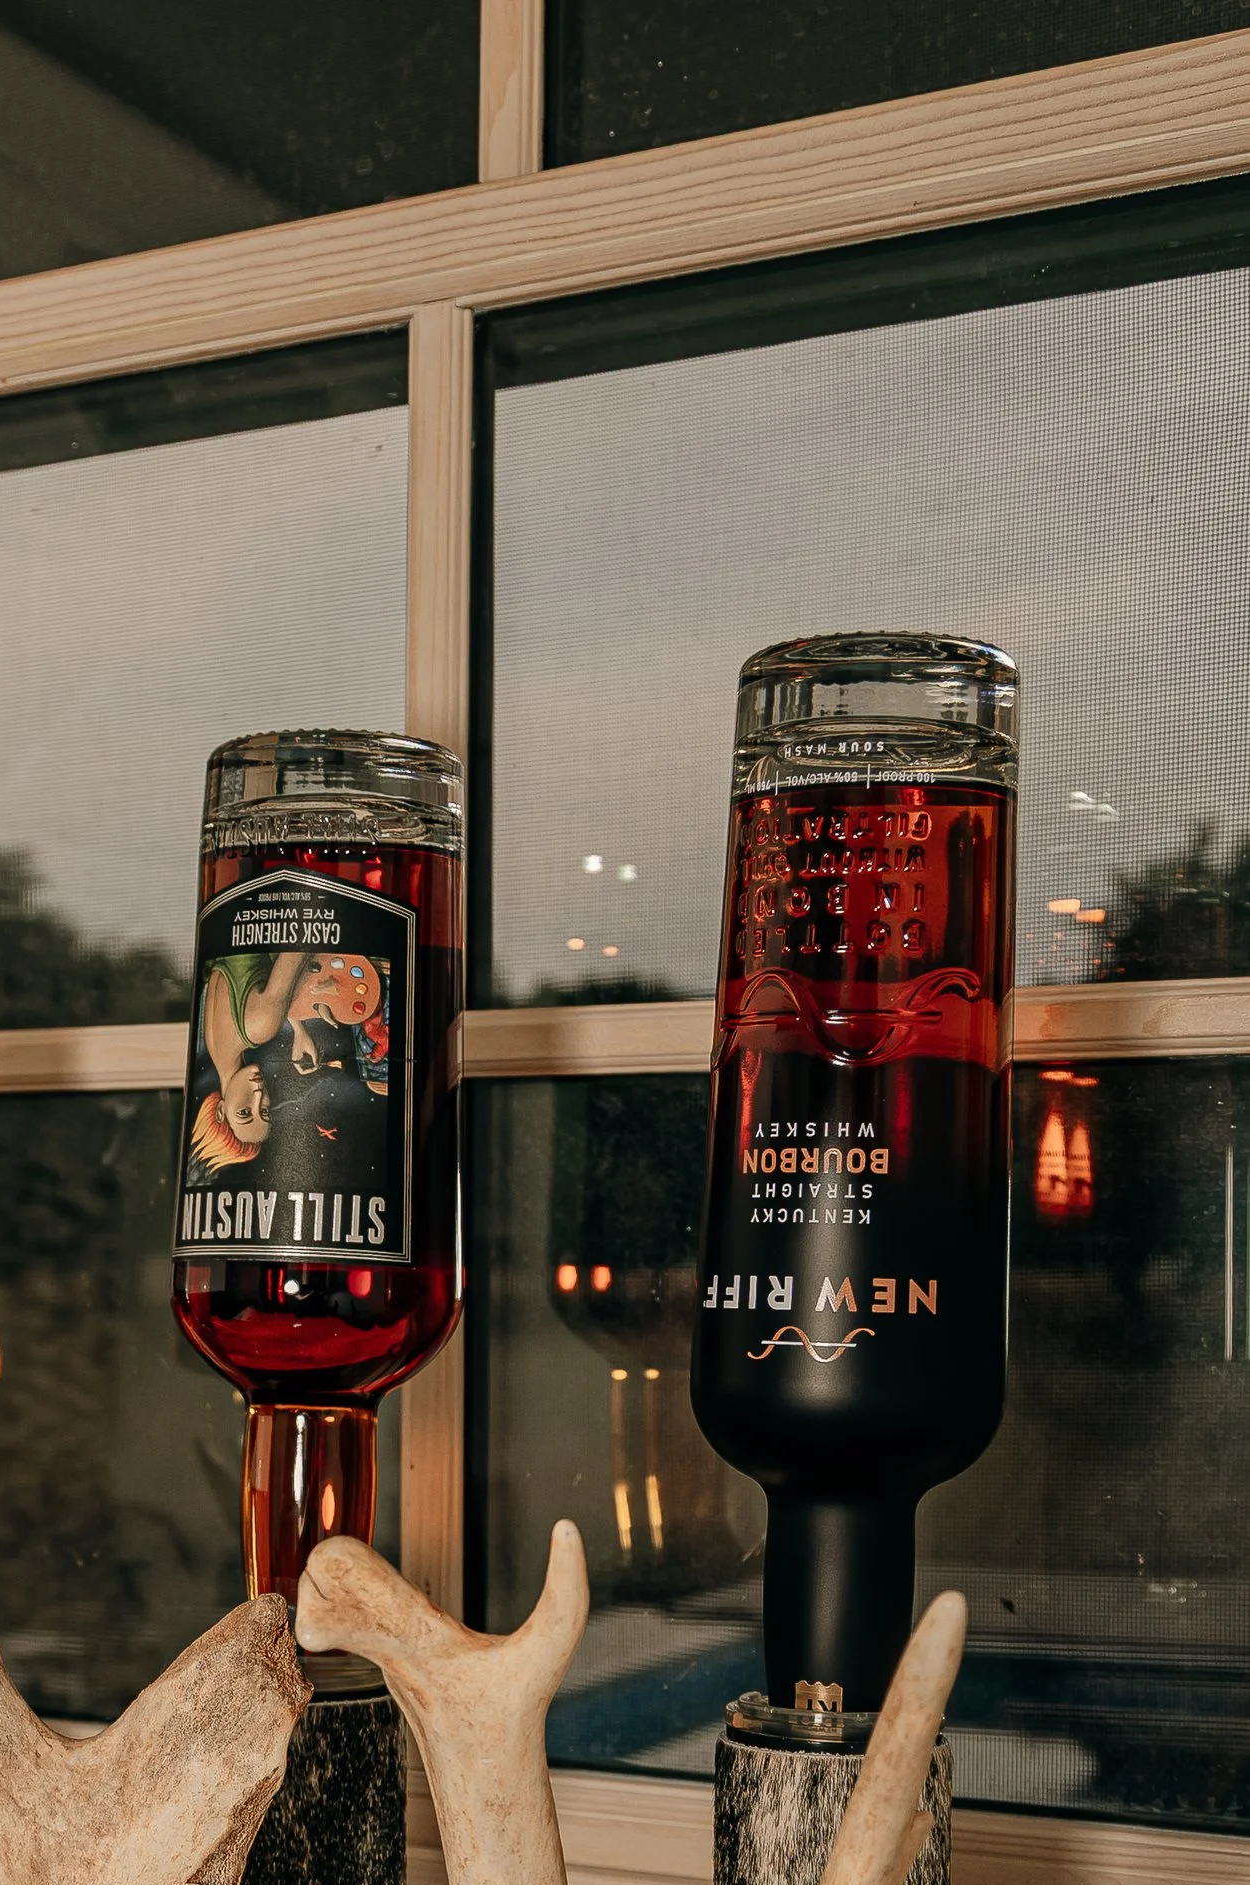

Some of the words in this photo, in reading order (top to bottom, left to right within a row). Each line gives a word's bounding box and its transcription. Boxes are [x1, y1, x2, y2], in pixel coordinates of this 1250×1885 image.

[784, 743, 826, 758] MASH
[838, 740, 884, 752] SOUR
[785, 772, 831, 787] ALC/VOL
[834, 771, 858, 782] 50%
[874, 771, 914, 782] PROOF
[917, 772, 936, 784] 100
[739, 812, 930, 851] FILTRATION
[800, 847, 925, 877] WITHOUT
[737, 883, 848, 922] BOND
[873, 883, 925, 912] IN
[234, 908, 298, 922] WHISKEY
[302, 908, 334, 920] RYE
[232, 922, 298, 946] STRENGTH
[302, 922, 340, 944] CASK
[735, 921, 925, 959] BOTTLED
[755, 1122, 874, 1138] WHISKEY
[742, 1148, 888, 1174] BOURBON
[752, 1183, 873, 1198] STRAIGHT
[182, 1190, 277, 1240] AUSTIN
[288, 1192, 386, 1244] STILL
[750, 1208, 871, 1224] KENTUCKY
[703, 1275, 793, 1310] RIFF
[815, 1276, 937, 1314] NEW
